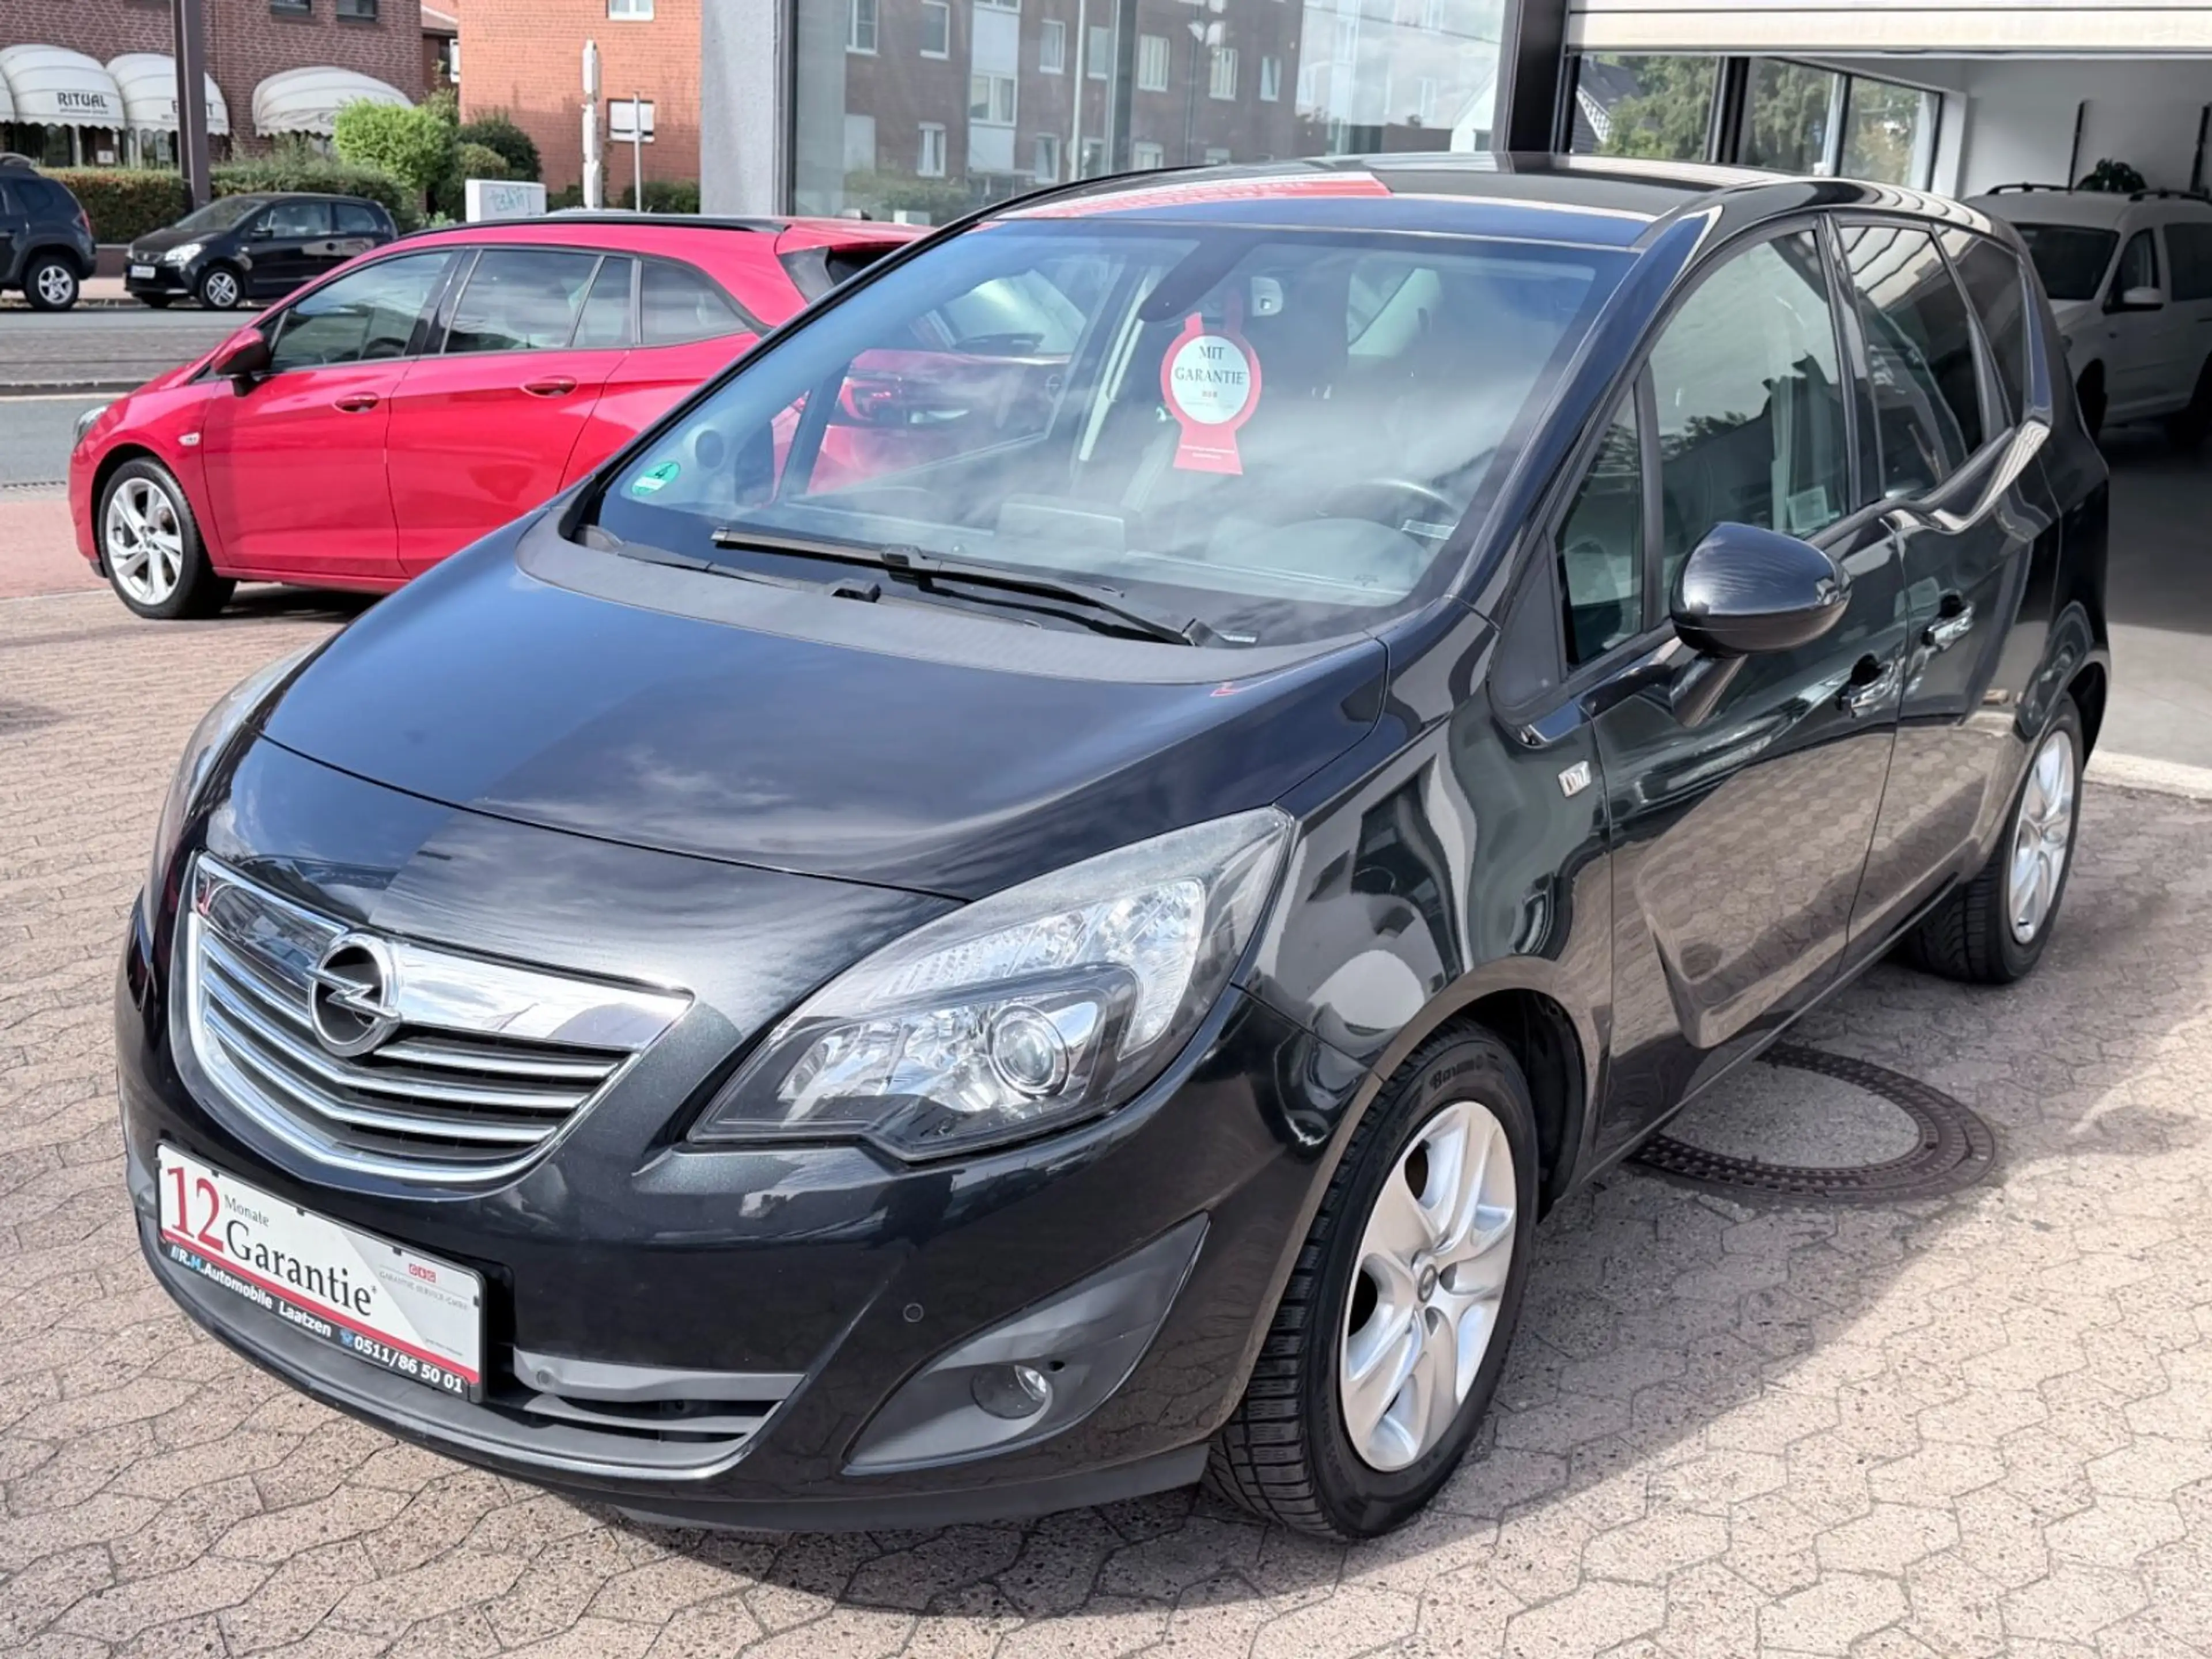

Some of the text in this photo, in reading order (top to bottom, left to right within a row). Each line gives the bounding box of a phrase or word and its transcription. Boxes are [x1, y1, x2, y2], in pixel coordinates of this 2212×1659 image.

[57, 92, 108, 108] RITUAL
[1199, 346, 1224, 360] MIT
[1174, 366, 1248, 385] GARANTIE
[168, 1166, 269, 1253] 12 Monate
[279, 1301, 332, 1338] Laatzen
[354, 1335, 417, 1375] 0511/86
[421, 1363, 440, 1384] 50
[443, 1373, 463, 1393] 01
